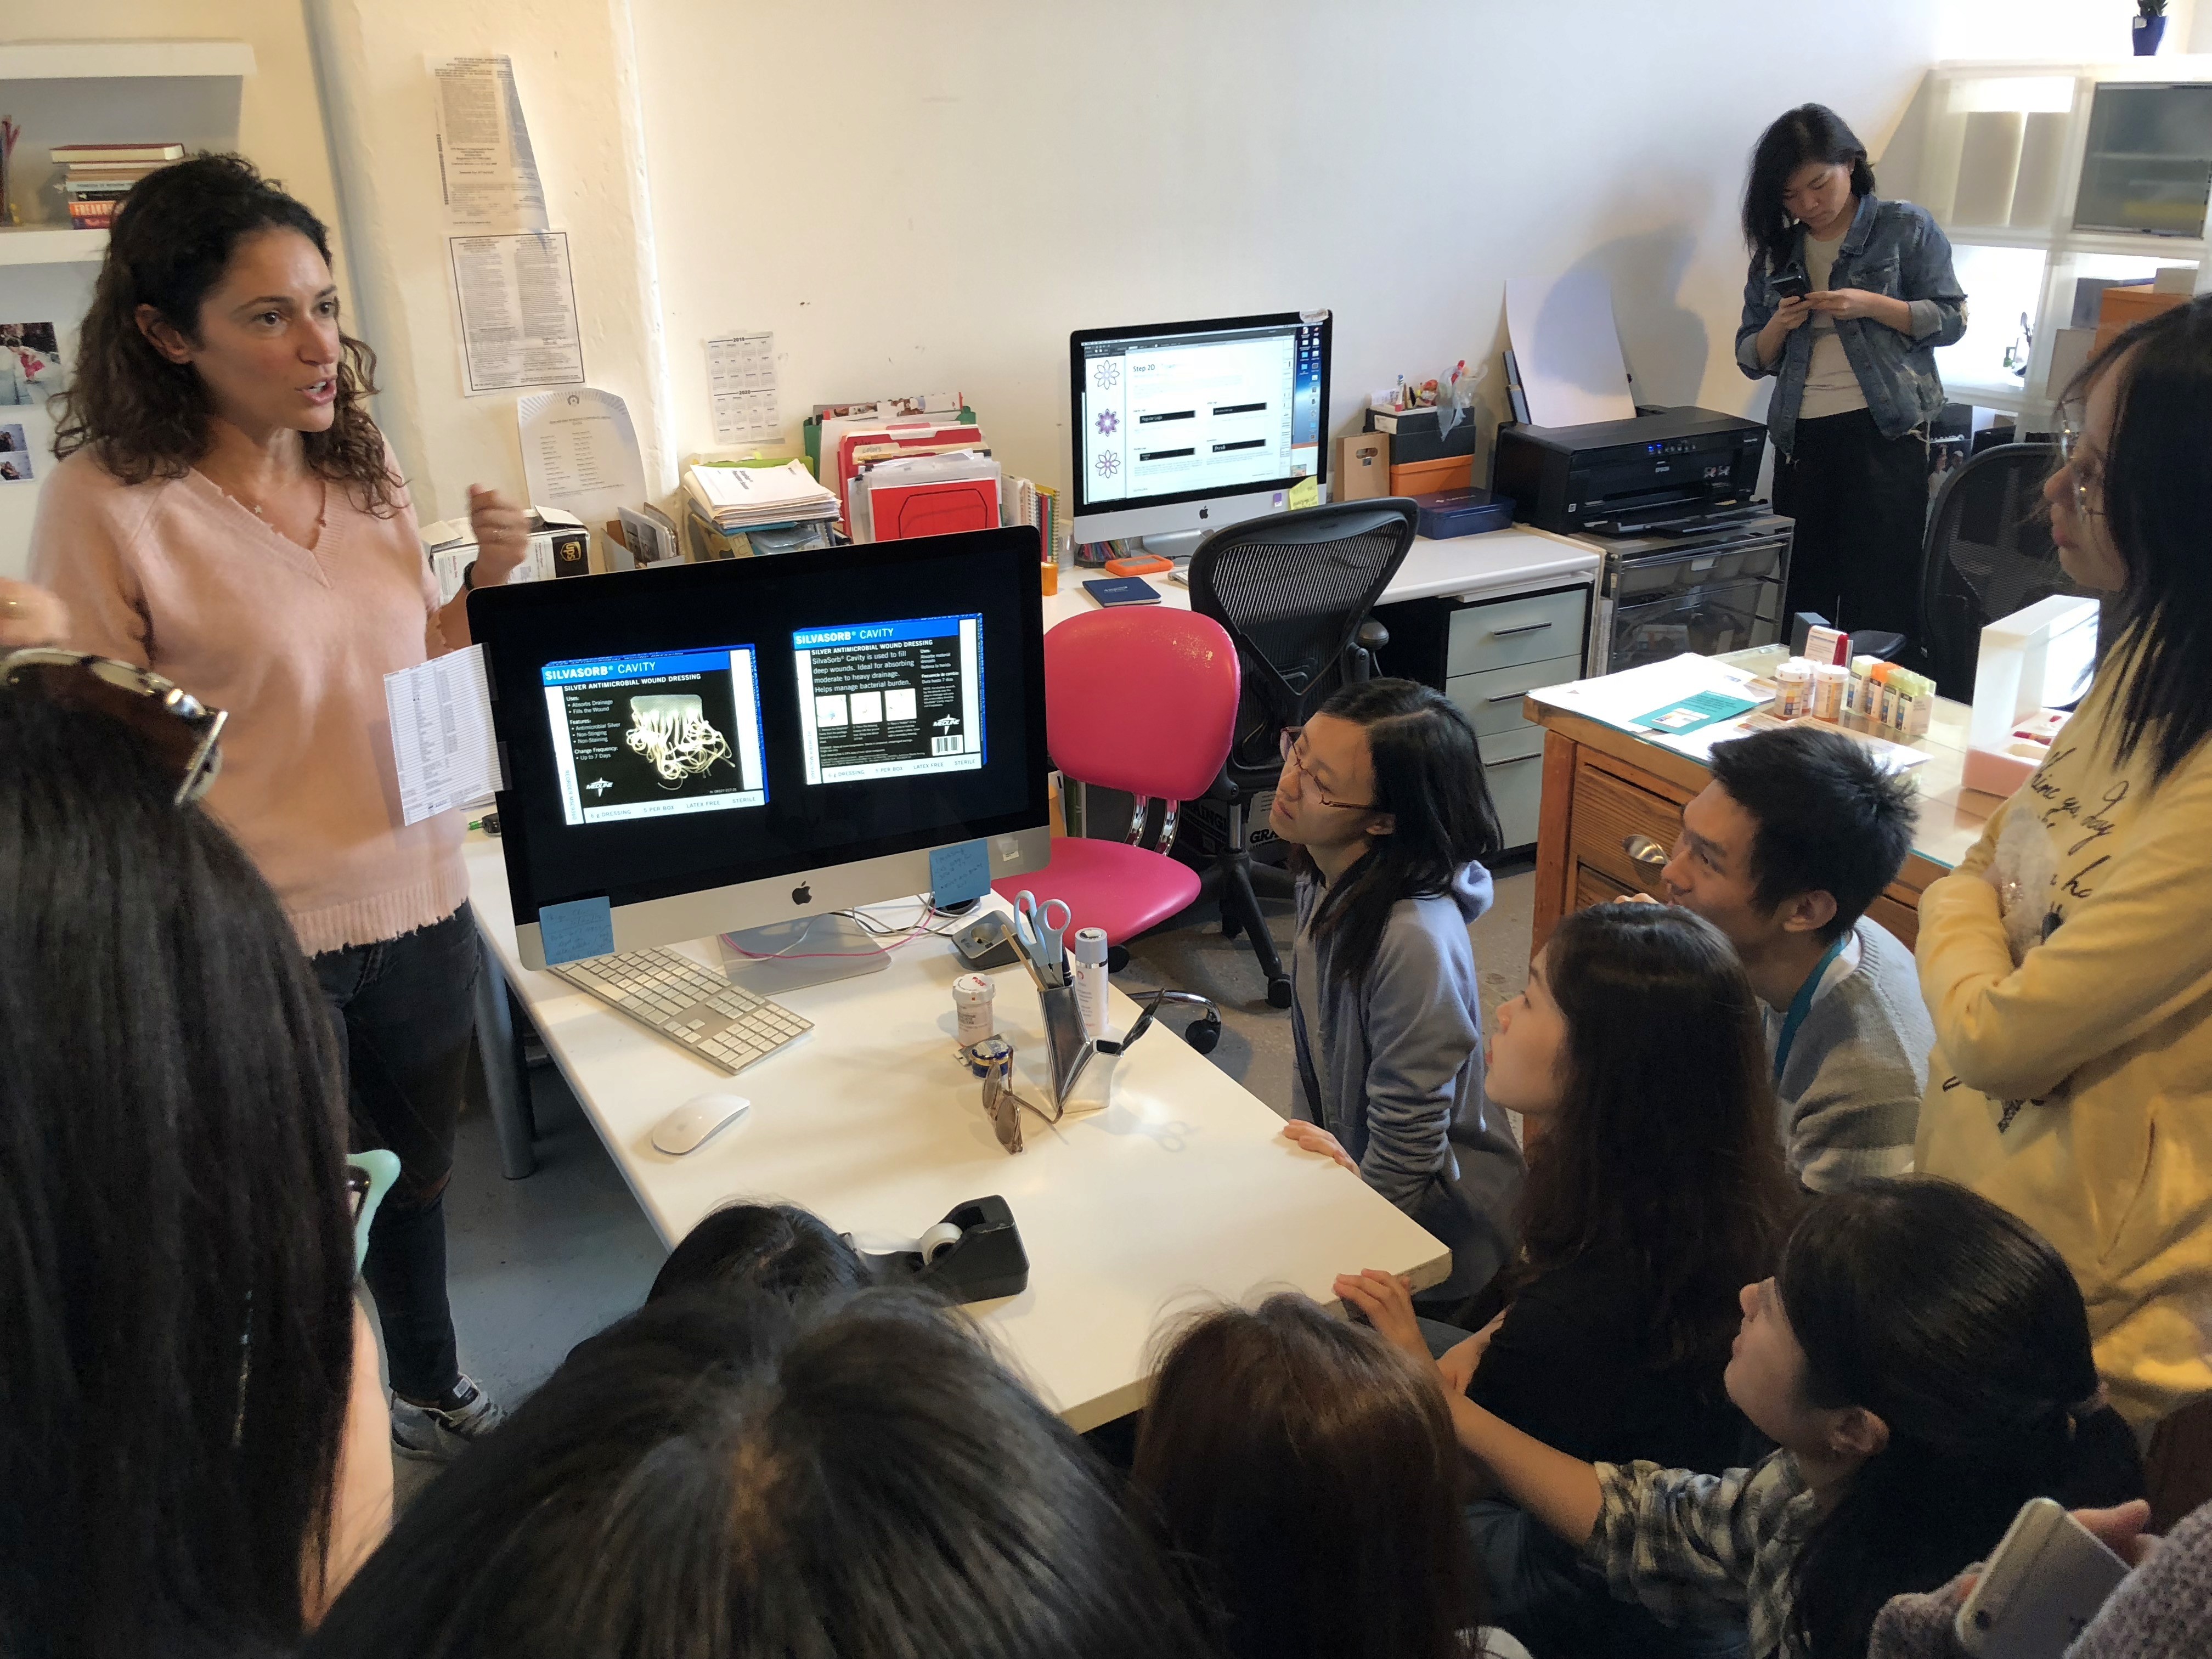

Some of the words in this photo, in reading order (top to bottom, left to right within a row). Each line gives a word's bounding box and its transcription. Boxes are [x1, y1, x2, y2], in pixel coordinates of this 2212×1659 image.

[563, 544, 575, 560] ups
[860, 628, 894, 639] CAVITY
[833, 644, 879, 653] ANTIMICROBIAL
[617, 661, 656, 674] CAVITY
[830, 665, 856, 673] wounds.
[884, 659, 915, 668] absorbing
[852, 673, 871, 681] heavy
[872, 670, 900, 679] drainage.
[564, 683, 587, 691] SILVER
[588, 679, 640, 690] ANTIMICROBIAL
[668, 673, 701, 682] DRESSING
[859, 681, 886, 689] bacterial
[933, 719, 961, 727] MEDLINE
[586, 782, 614, 790] MEDLINE
[601, 809, 631, 817] DRESSING
